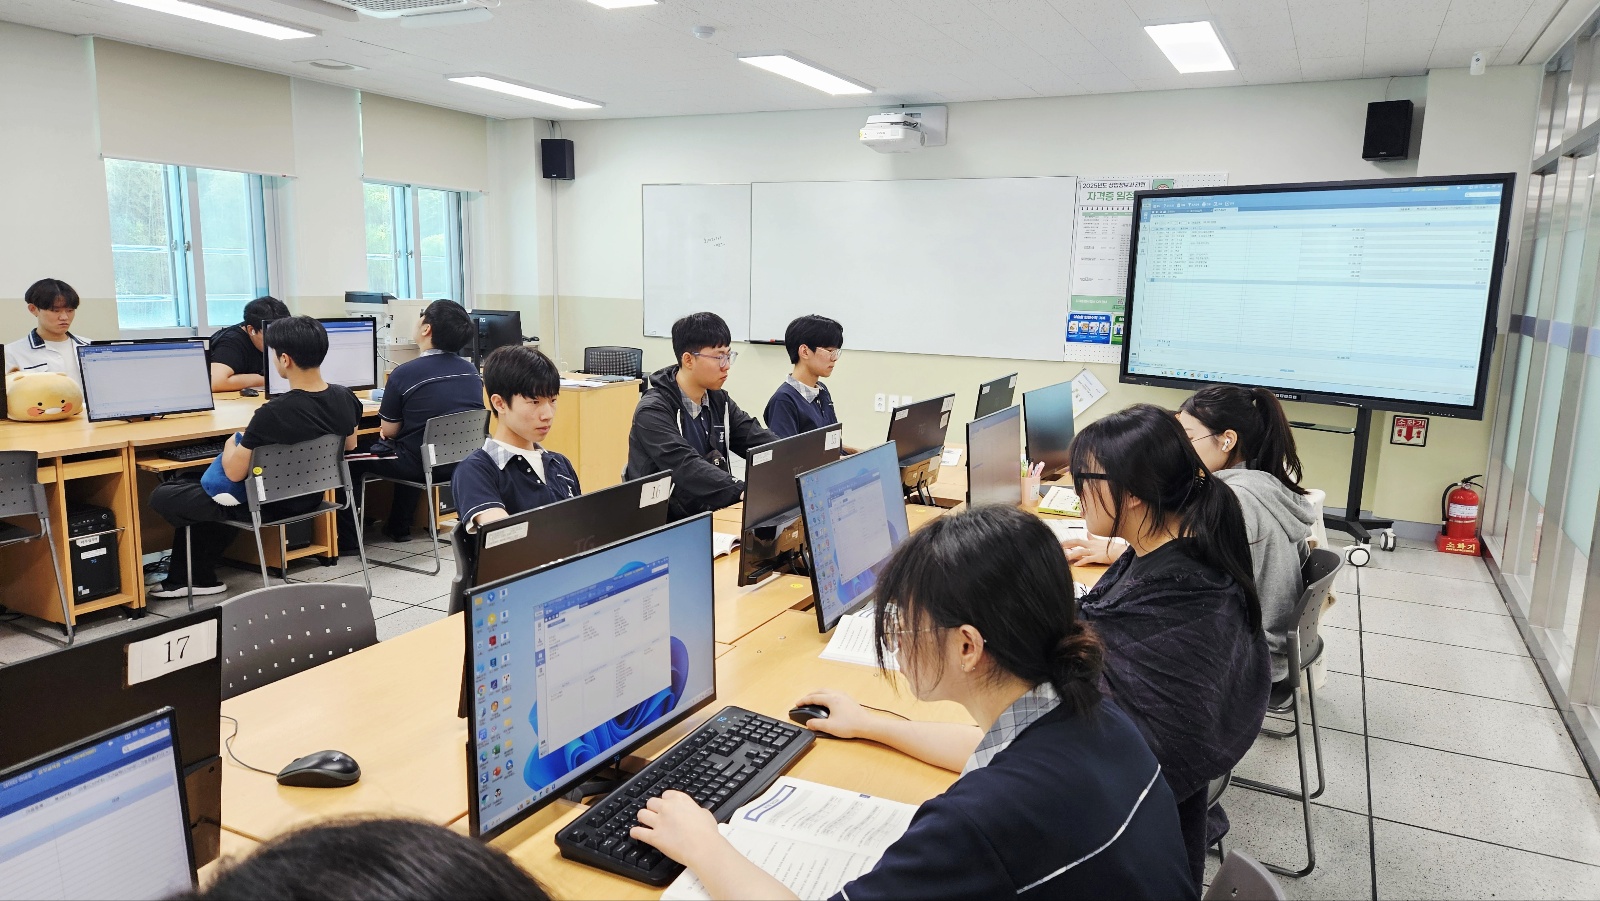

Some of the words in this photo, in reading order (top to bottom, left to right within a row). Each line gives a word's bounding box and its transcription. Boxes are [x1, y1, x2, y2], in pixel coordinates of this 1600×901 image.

[1087, 191, 1114, 201] 자격증
[1398, 419, 1425, 427] 소화기
[650, 485, 661, 500] 16
[1446, 541, 1475, 550] 소화기
[163, 635, 190, 664] 17
